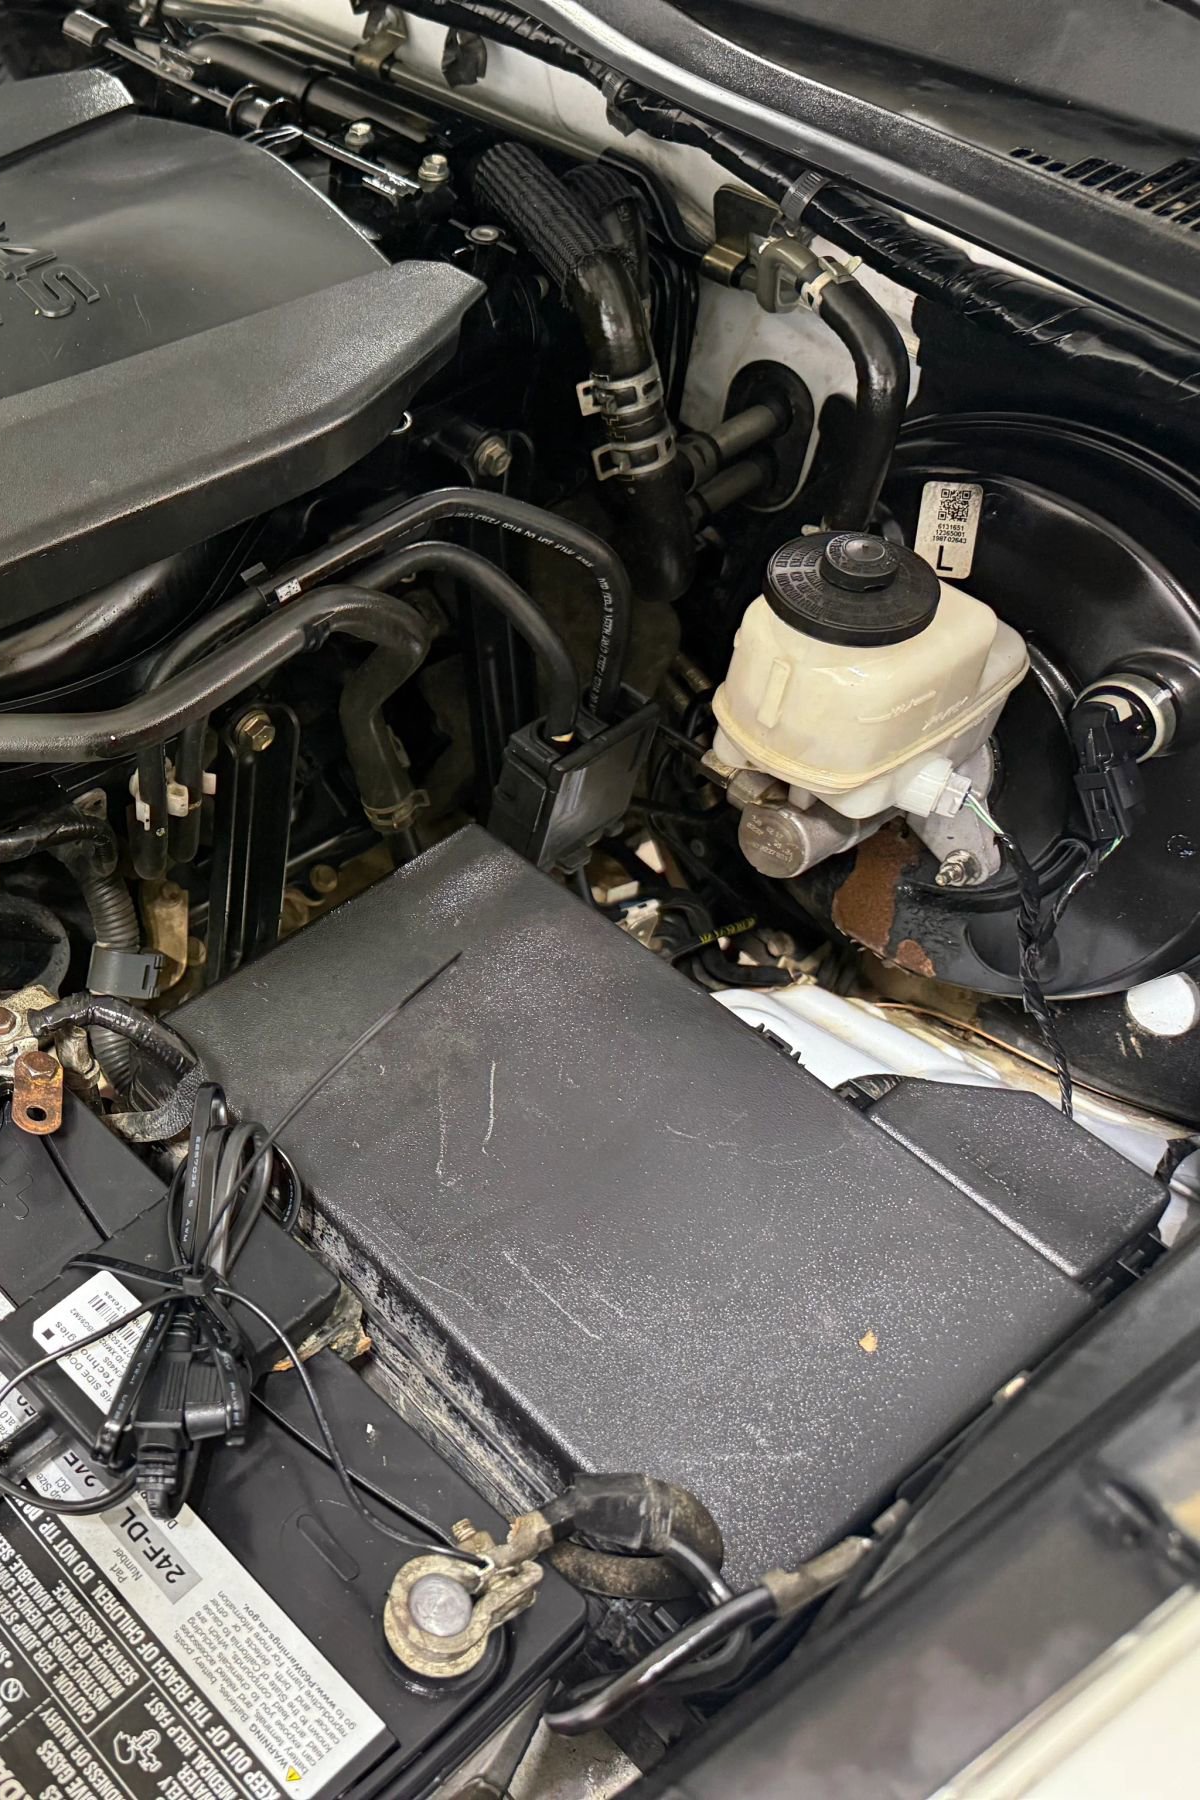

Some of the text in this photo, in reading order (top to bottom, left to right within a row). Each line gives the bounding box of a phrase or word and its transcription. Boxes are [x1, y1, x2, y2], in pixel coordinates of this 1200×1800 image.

[936, 545, 953, 571] L
[53, 1320, 115, 1386] Technogies
[81, 1369, 101, 1390] SIDE
[35, 1472, 52, 1492] Size
[54, 1476, 70, 1493] BCI
[35, 1516, 63, 1543] TIP.
[113, 1505, 185, 1585] 24F-DL
[51, 1536, 81, 1565] NOT
[111, 1546, 142, 1580] Number
[8, 1552, 56, 1612] AVAILABLE,
[71, 1559, 95, 1583] DO
[108, 1563, 127, 1583] Part
[7, 1584, 46, 1628] VEHICLE
[47, 1606, 72, 1632] NOT
[87, 1578, 146, 1645] CHILDREN.
[10, 1619, 42, 1653] JUMP
[38, 1623, 56, 1640] IN
[51, 1579, 139, 1685] SERVICE ASSISTANCE.
[62, 1626, 80, 1643] IF
[71, 1637, 93, 1658] OR
[31, 1645, 58, 1673] FOR
[135, 1638, 161, 1662] OF
[215, 1589, 348, 1738] reproductive harm. For more information
[241, 1602, 356, 1730] go to www.P65Warnings.ca.gov.
[47, 1634, 111, 1711] INSTRUCTIONS
[82, 1650, 125, 1698] MANUAL
[150, 1655, 194, 1702] REACH
[194, 1610, 324, 1760] lead and lead compounds, which are
[201, 1603, 332, 1753] known to the State of California to cause
[208, 1596, 339, 1745] cancer and birth defects or other
[50, 1669, 97, 1724] CAUTION:
[170, 1630, 288, 1769] WARNING Batteries, battery posts,
[178, 1623, 308, 1774] battery terminals, and related accessories
[185, 1615, 316, 1767] can expose you to chemicals including
[143, 1691, 175, 1728] FAST.
[182, 1695, 214, 1727] THE
[37, 1705, 79, 1750] INJURY
[165, 1723, 198, 1757] HELP
[205, 1721, 231, 1747] OF
[34, 1737, 76, 1785] GASES
[68, 1743, 92, 1767] OR
[220, 1739, 254, 1773] OUT
